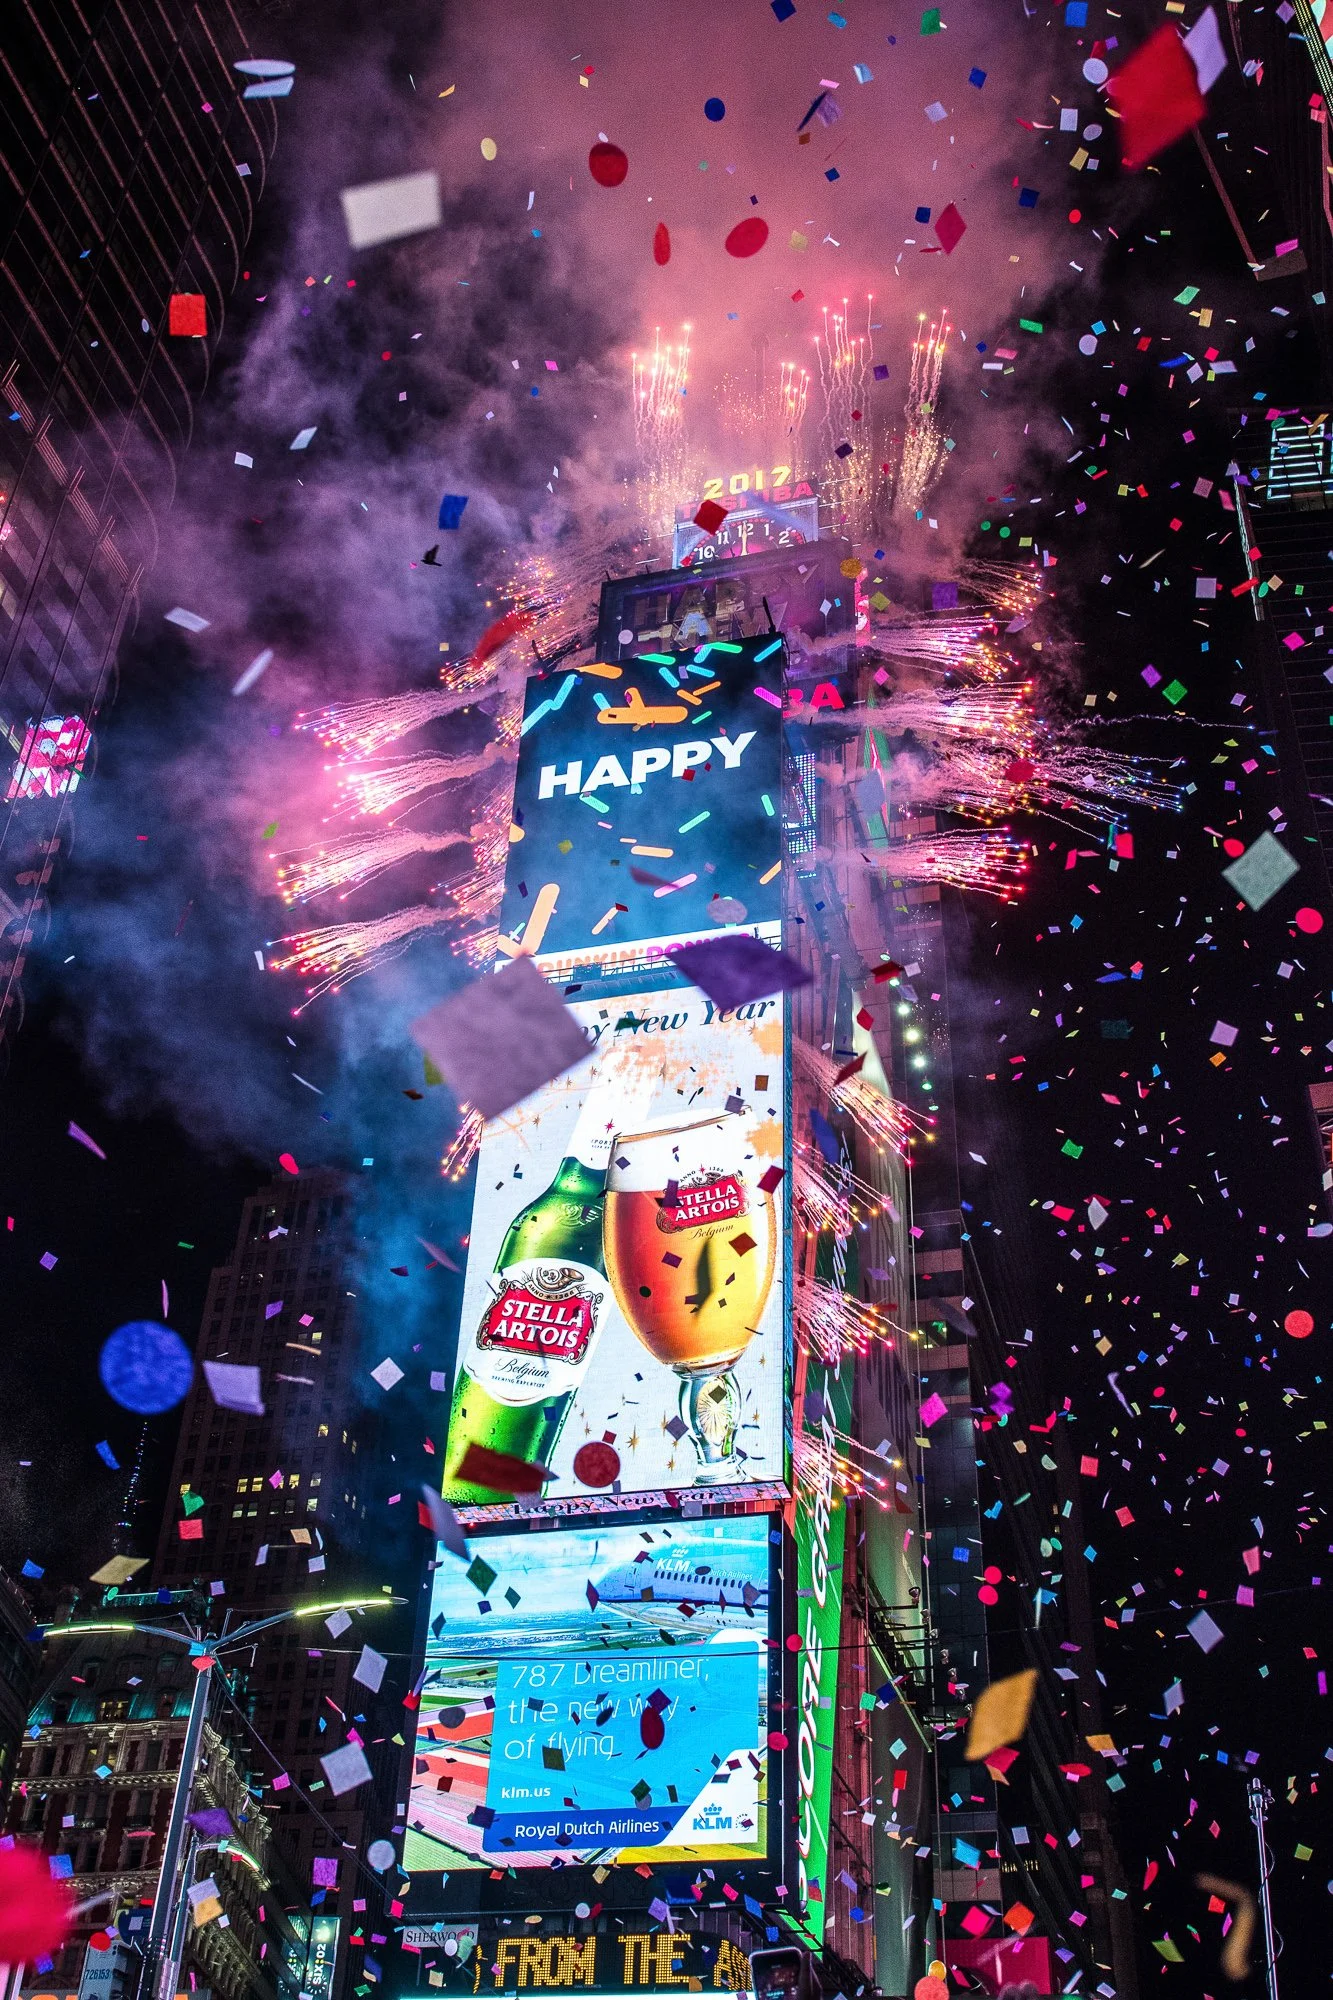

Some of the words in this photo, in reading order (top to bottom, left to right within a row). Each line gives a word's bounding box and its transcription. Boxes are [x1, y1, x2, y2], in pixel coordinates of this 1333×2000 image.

[703, 465, 792, 501] 2017
[678, 481, 814, 519] TSIBA
[538, 731, 757, 800] HAPPY
[675, 1196, 740, 1222] ARTOIS
[689, 1224, 734, 1241] Belgium
[501, 1299, 584, 1328] STELLA
[493, 1319, 580, 1348] ARTOIS
[495, 1358, 550, 1379] Belgium
[663, 1490, 720, 1503] ear
[656, 1558, 692, 1573] KLM
[511, 1663, 566, 1690] 787
[507, 1697, 559, 1725] the
[628, 1695, 680, 1722] wy
[503, 1736, 536, 1761] of
[501, 1786, 552, 1800] klm.us
[515, 1822, 561, 1839] Royal
[564, 1821, 606, 1837] Dutch
[607, 1819, 661, 1836] Airlines
[693, 1816, 732, 1830] KLM
[312, 1943, 327, 1985] SIX:02
[494, 1936, 597, 1988] FROM
[618, 1934, 691, 1985] THE
